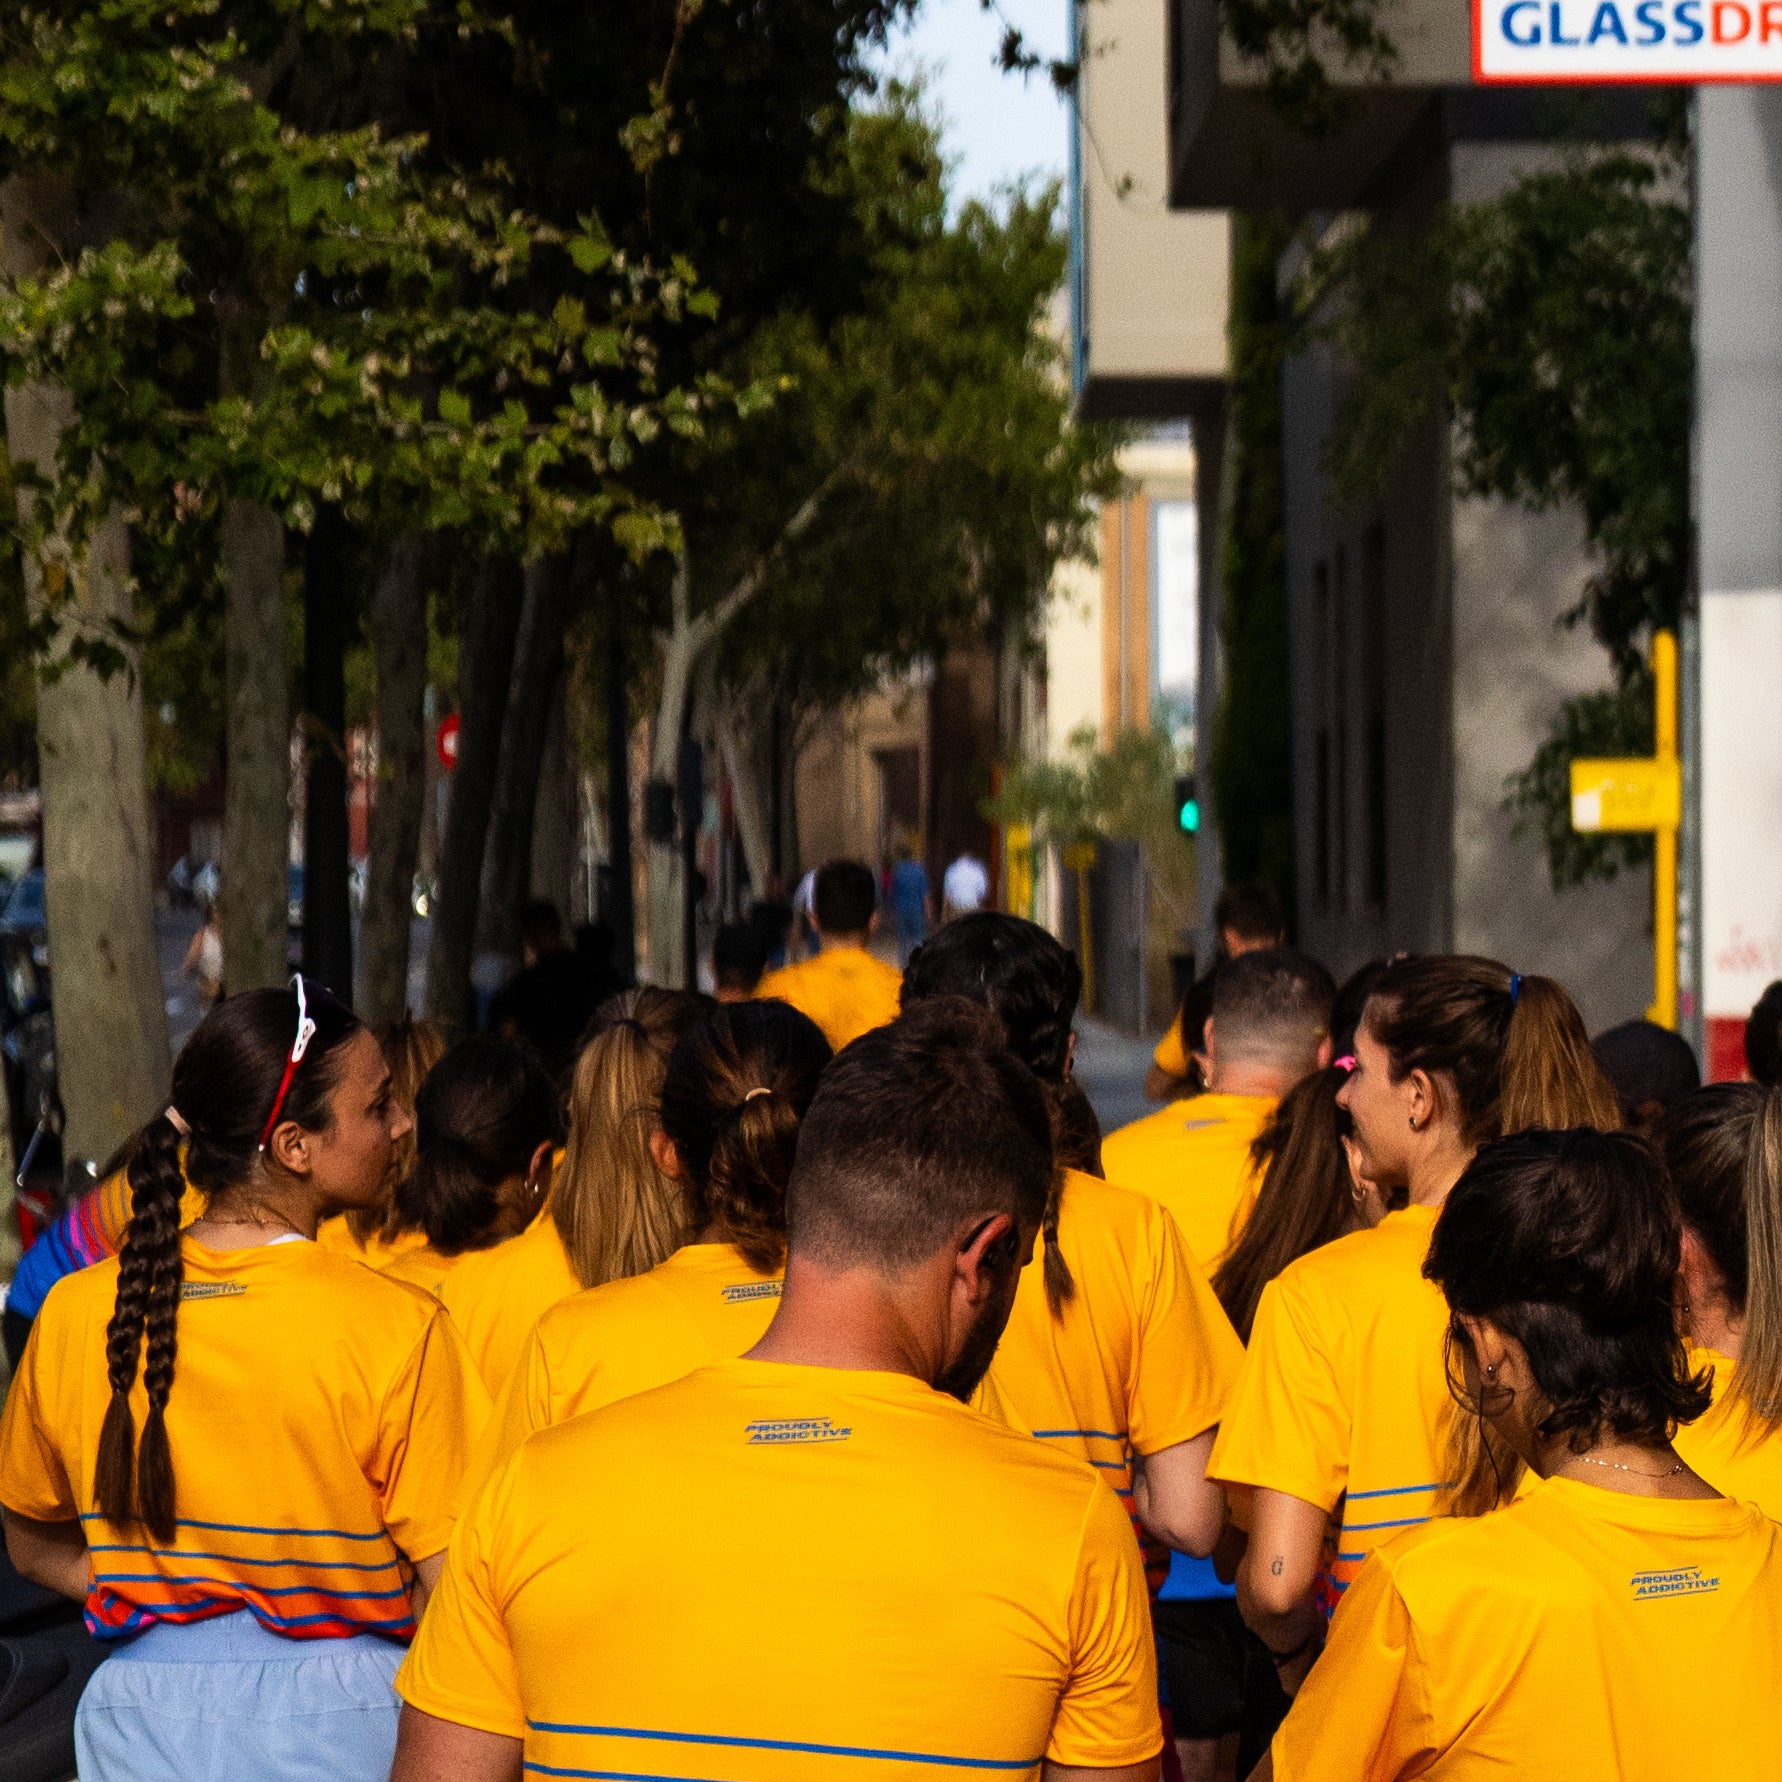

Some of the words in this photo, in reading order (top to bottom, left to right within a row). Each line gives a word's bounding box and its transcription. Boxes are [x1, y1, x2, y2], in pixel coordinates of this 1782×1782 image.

[745, 1421, 833, 1433] PROUDLY
[750, 1427, 852, 1440] ADDICTIVE
[1629, 1570, 1702, 1586] PROUDLY
[1636, 1577, 1720, 1596] ADDICTIVE
